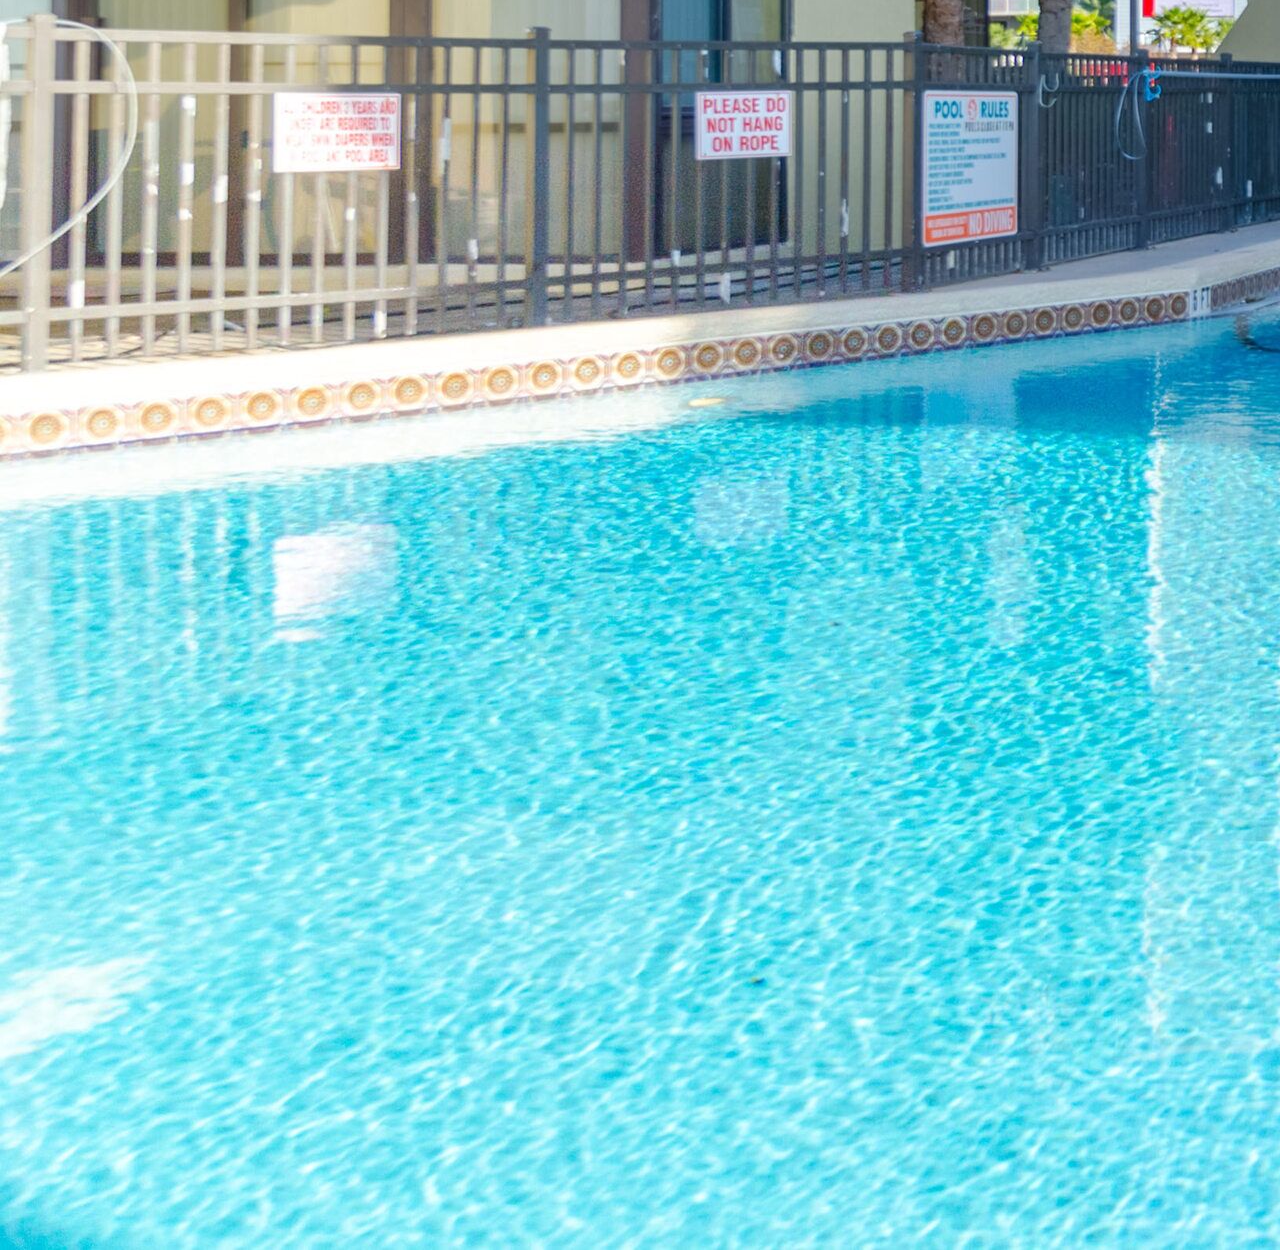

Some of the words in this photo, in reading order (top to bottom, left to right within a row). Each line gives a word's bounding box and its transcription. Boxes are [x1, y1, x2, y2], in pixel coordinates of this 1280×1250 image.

[351, 101, 378, 114] YEARS
[703, 98, 760, 114] PLEASE
[766, 97, 786, 113] DO
[934, 100, 964, 118] POOL
[981, 101, 1009, 118] RULES
[338, 117, 378, 130] REQUIRED
[380, 117, 392, 130] TO
[706, 117, 736, 133] NOT
[742, 116, 784, 132] HANG
[336, 133, 369, 146] DIAPERS
[371, 133, 395, 146] WHEN
[712, 137, 734, 152] ON
[739, 135, 779, 151] ROPE
[969, 212, 983, 235] NO
[983, 208, 1015, 233] DIVING
